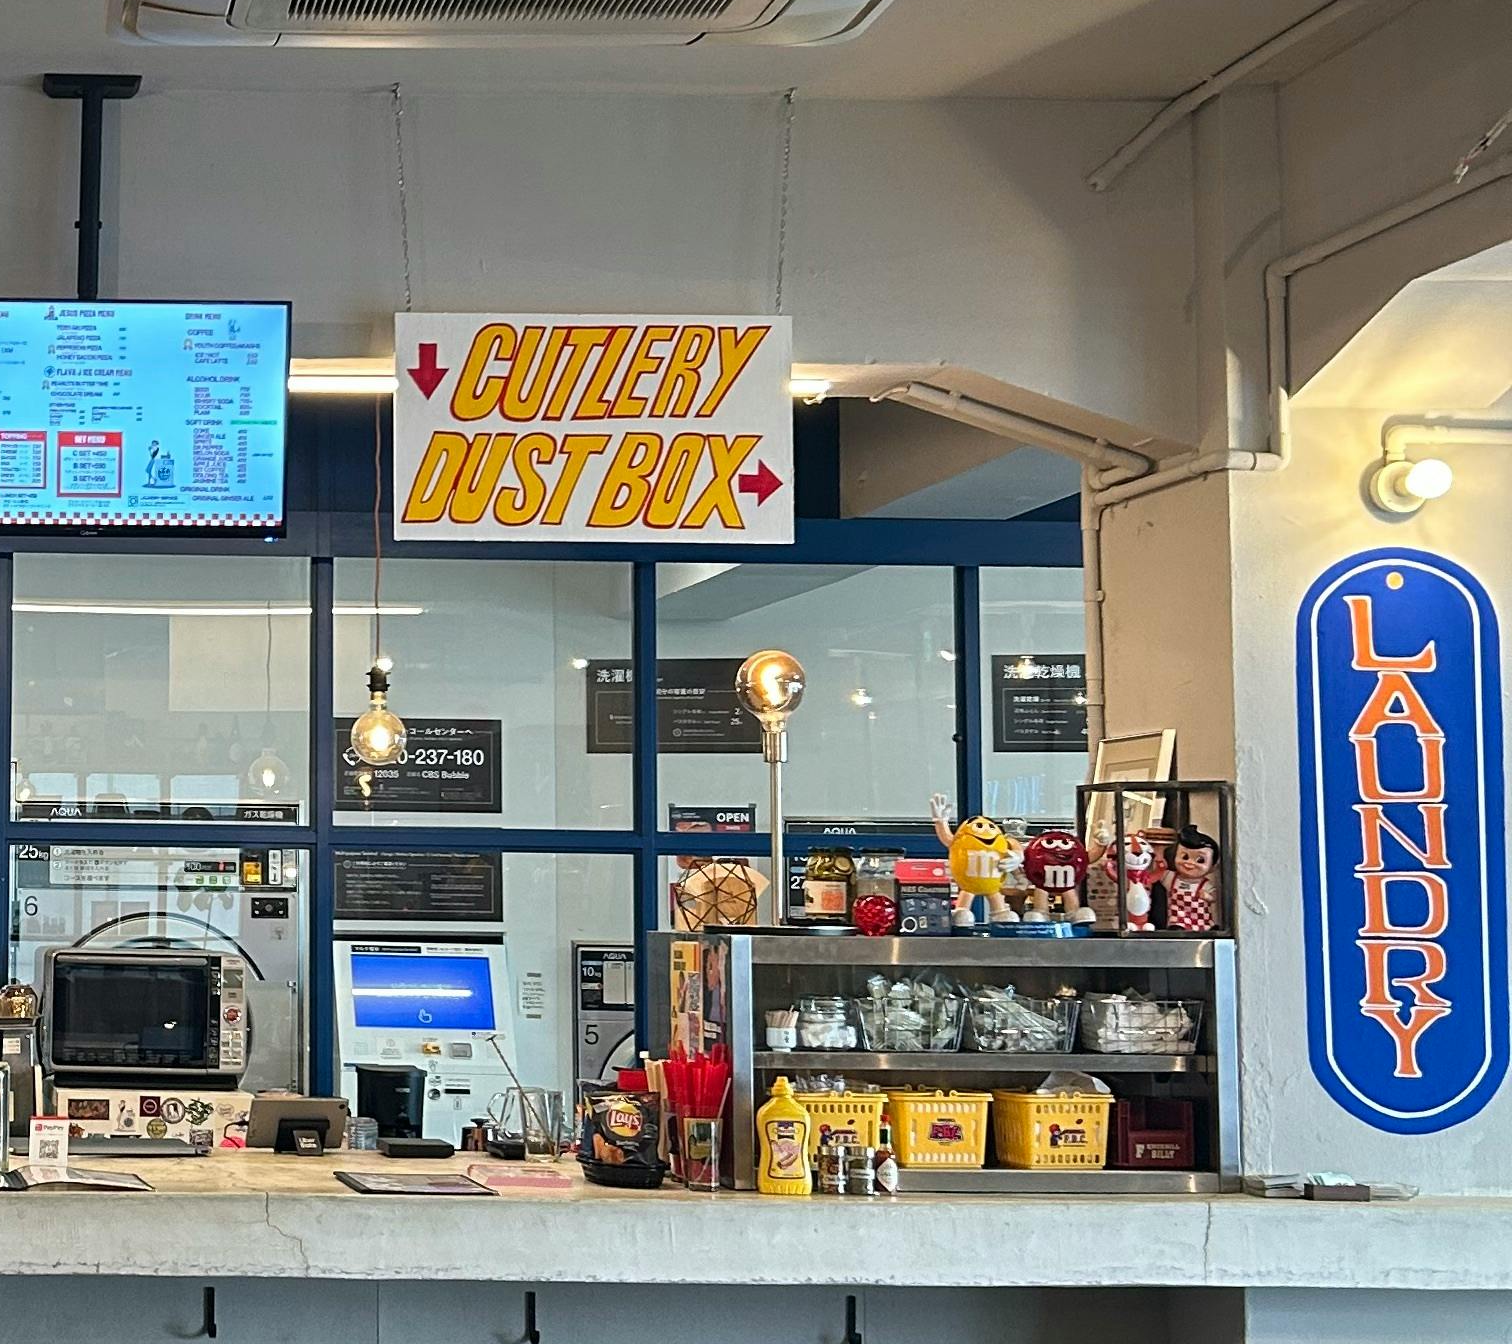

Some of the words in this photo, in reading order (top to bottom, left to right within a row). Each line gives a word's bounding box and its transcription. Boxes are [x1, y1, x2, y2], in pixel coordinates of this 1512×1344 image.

[450, 323, 772, 423] CUTLERY
[401, 431, 612, 525] DUST
[585, 432, 763, 530] BOX
[50, 808, 82, 818] AQUA
[716, 812, 750, 823] OPEN
[1341, 594, 1453, 1079] LAUNDRY
[1044, 864, 1076, 888] m
[24, 895, 38, 916] 6
[584, 1023, 600, 1045] 5
